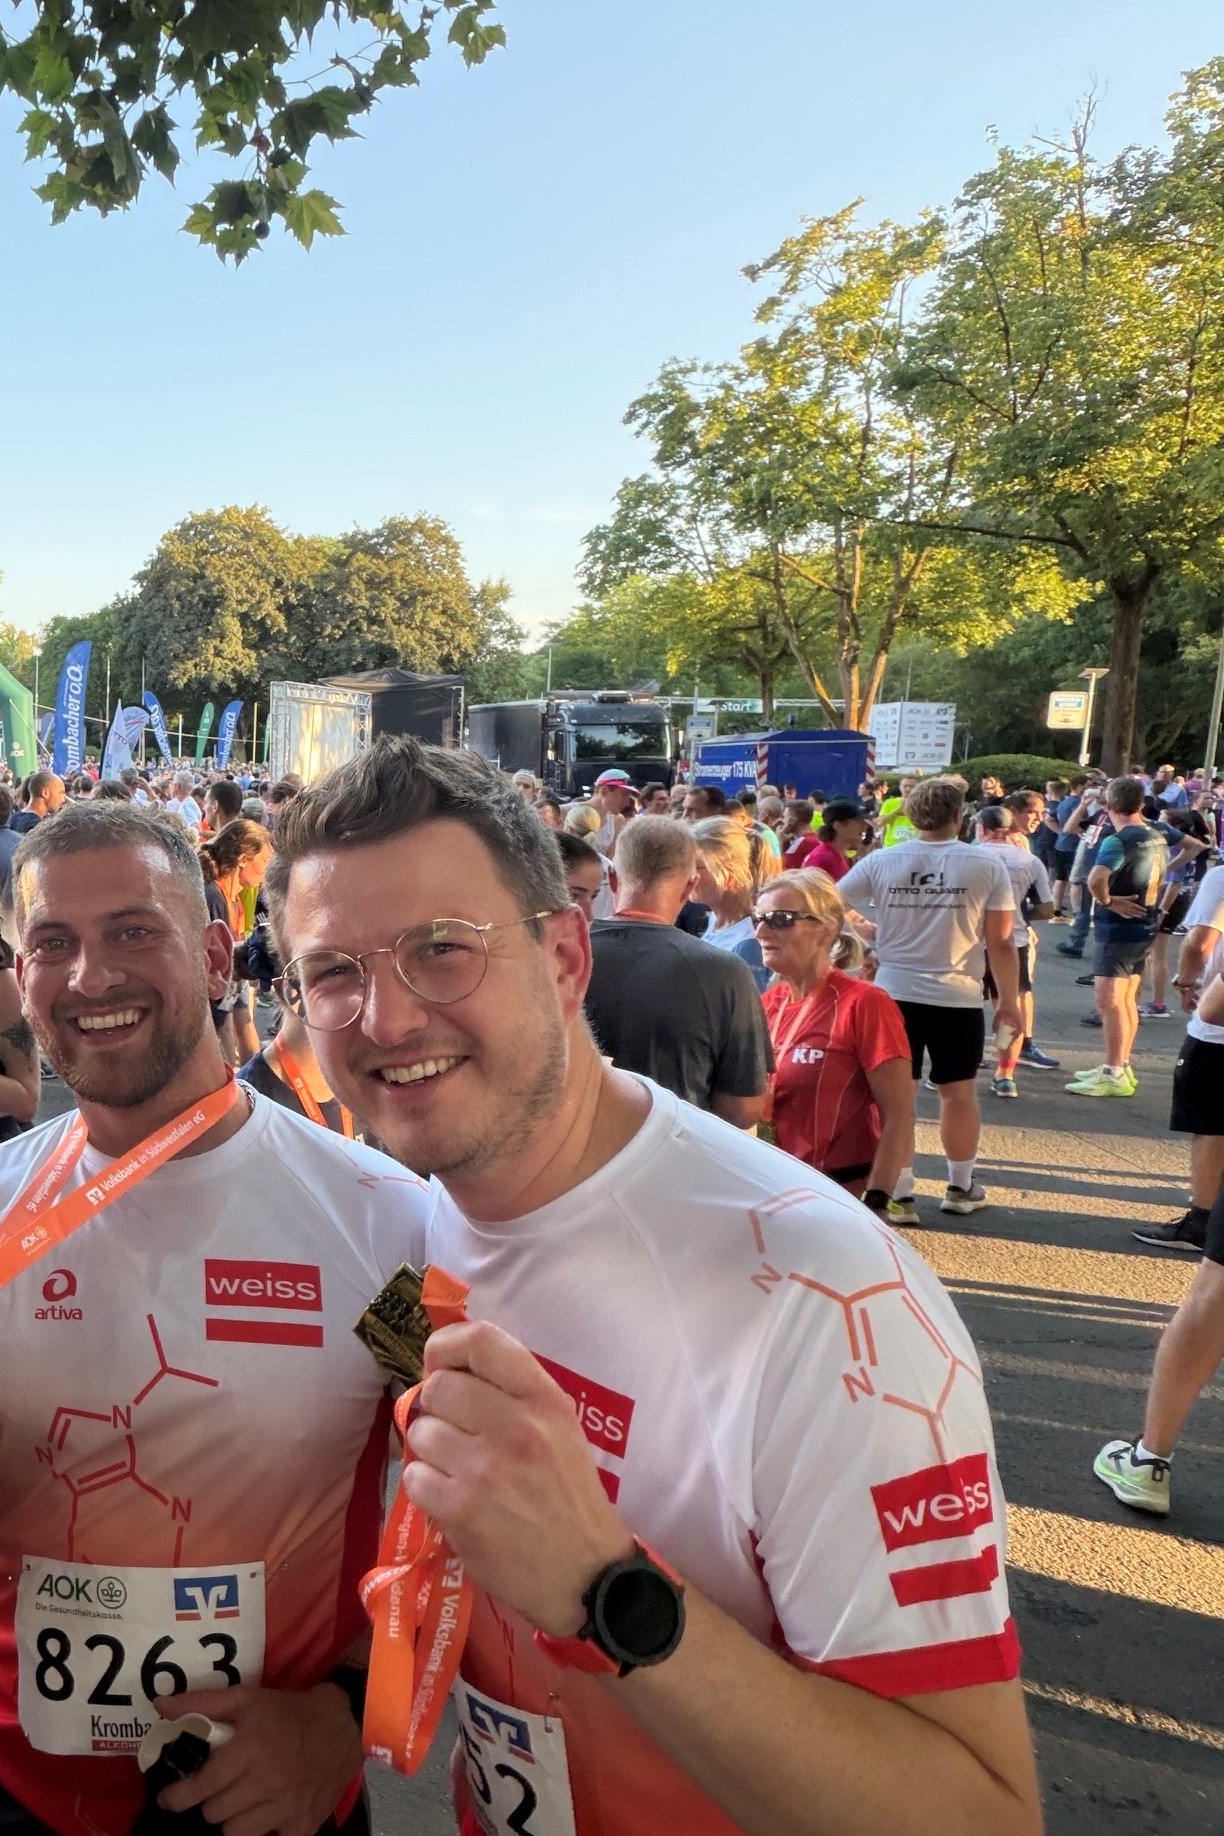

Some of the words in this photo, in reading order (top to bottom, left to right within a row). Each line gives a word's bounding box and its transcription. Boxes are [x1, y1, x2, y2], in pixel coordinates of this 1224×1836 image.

[733, 761, 743, 778] 175
[889, 887, 920, 895] OTTO
[925, 887, 968, 895] QUAST
[792, 1048, 824, 1064] KP
[101, 1160, 141, 1192] Volksbank
[147, 1121, 194, 1158] Südwestfalen
[193, 1110, 206, 1124] eG
[209, 1272, 317, 1301] weiss
[34, 1305, 83, 1320] artiva
[578, 1391, 624, 1442] iss
[883, 1478, 989, 1534] wess
[36, 1573, 93, 1603] AOK
[35, 1602, 47, 1612] Die
[48, 1604, 124, 1621] Gesundheitskasse.
[35, 1627, 242, 1706] 8263
[91, 1715, 153, 1738] Kromba
